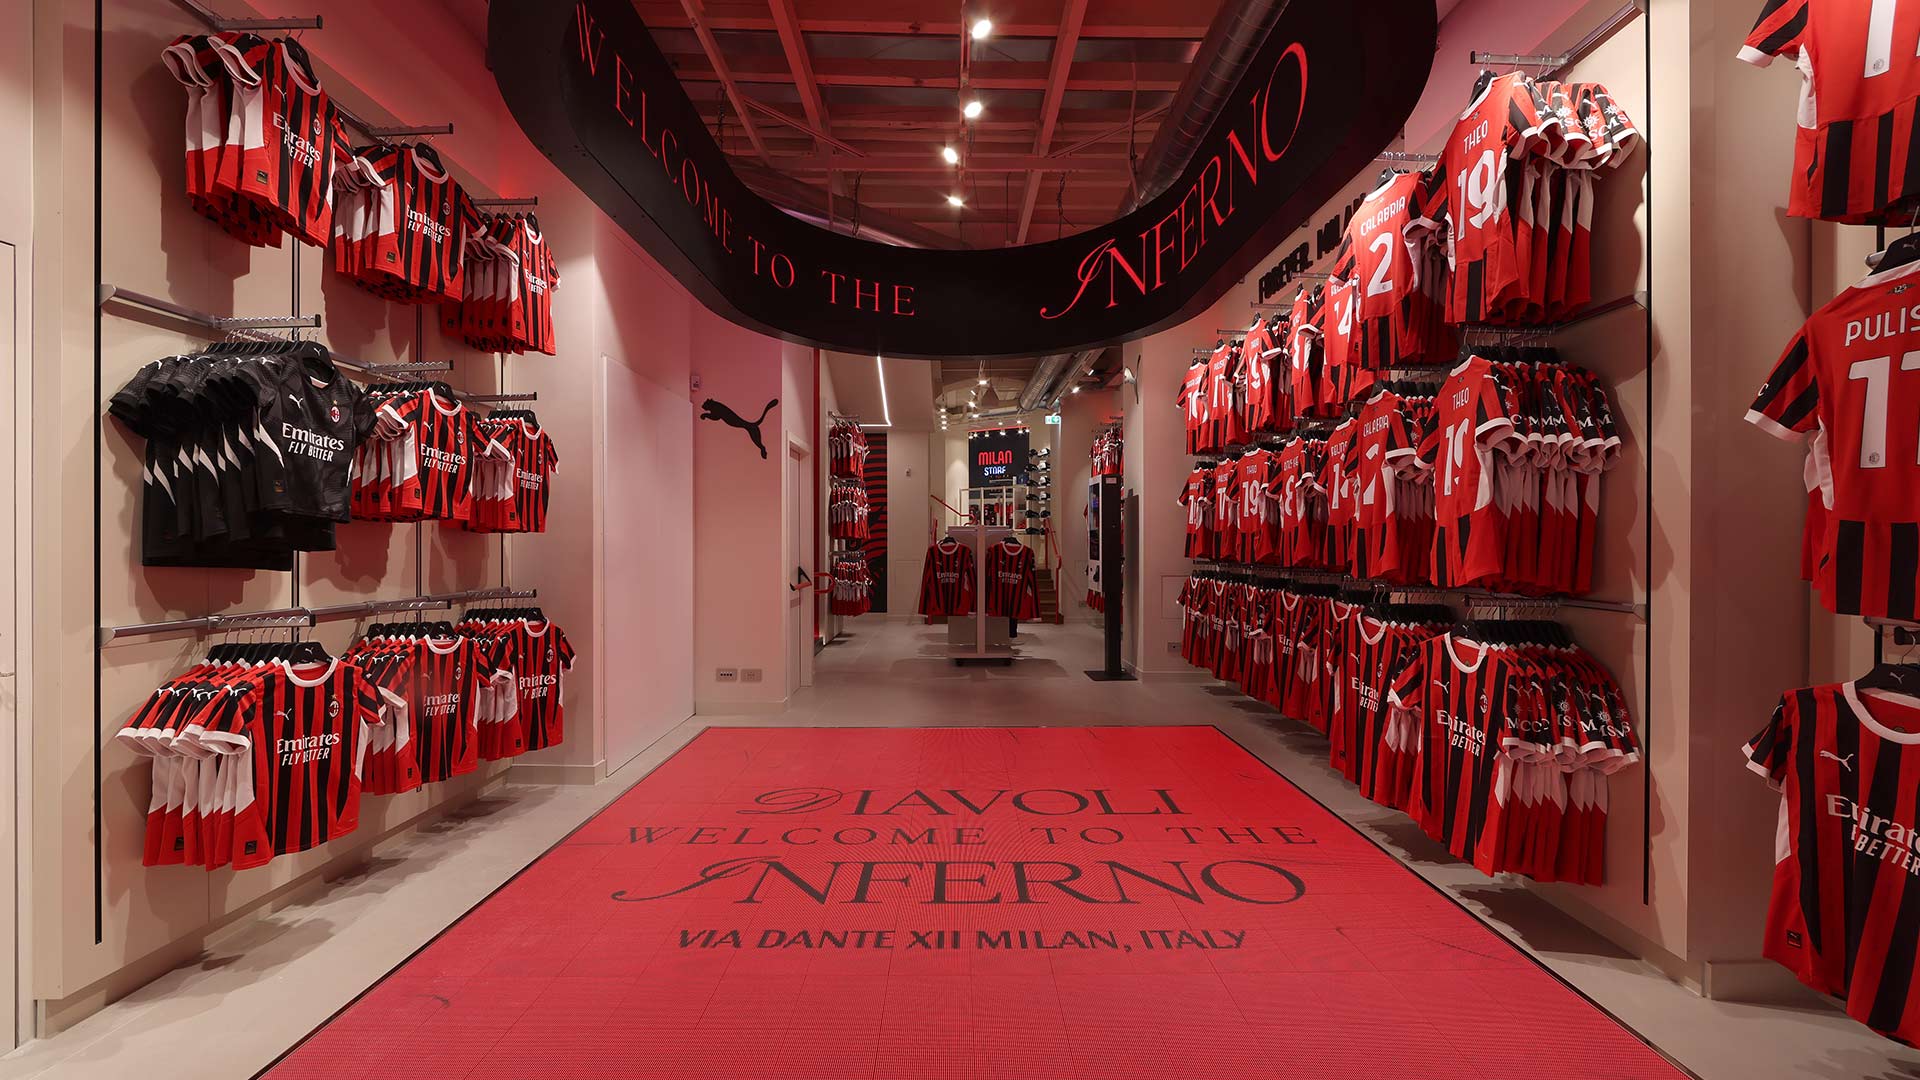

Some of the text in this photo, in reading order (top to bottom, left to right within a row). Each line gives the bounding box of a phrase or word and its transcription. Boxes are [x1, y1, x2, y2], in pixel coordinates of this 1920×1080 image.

[1464, 120, 1489, 154] THEO
[576, 1, 916, 316] WELCOME TO THE
[1040, 42, 1308, 320] INFERNO
[1457, 149, 1495, 241] 19
[1360, 196, 1406, 237] CALABRIA
[1367, 231, 1394, 298] 2
[1453, 387, 1470, 411] THEO
[282, 422, 345, 451] Emirates
[288, 441, 334, 462] FLY BETTER
[978, 450, 1013, 466] MILAN
[437, 460, 458, 474] ETTER
[1243, 480, 1261, 518] 19
[276, 732, 340, 754] Emirates
[1452, 734, 1481, 757] BETTER
[281, 752, 302, 767] FLY
[735, 787, 1193, 816] DIAVOLI
[627, 826, 1318, 845] WELCOME TO THE
[1825, 793, 1920, 854] Eirat
[1854, 833, 1920, 876] BETTER
[611, 855, 1306, 905] INFERNO
[678, 930, 1247, 952] VIA DANTE XII MILAN, ITALY
